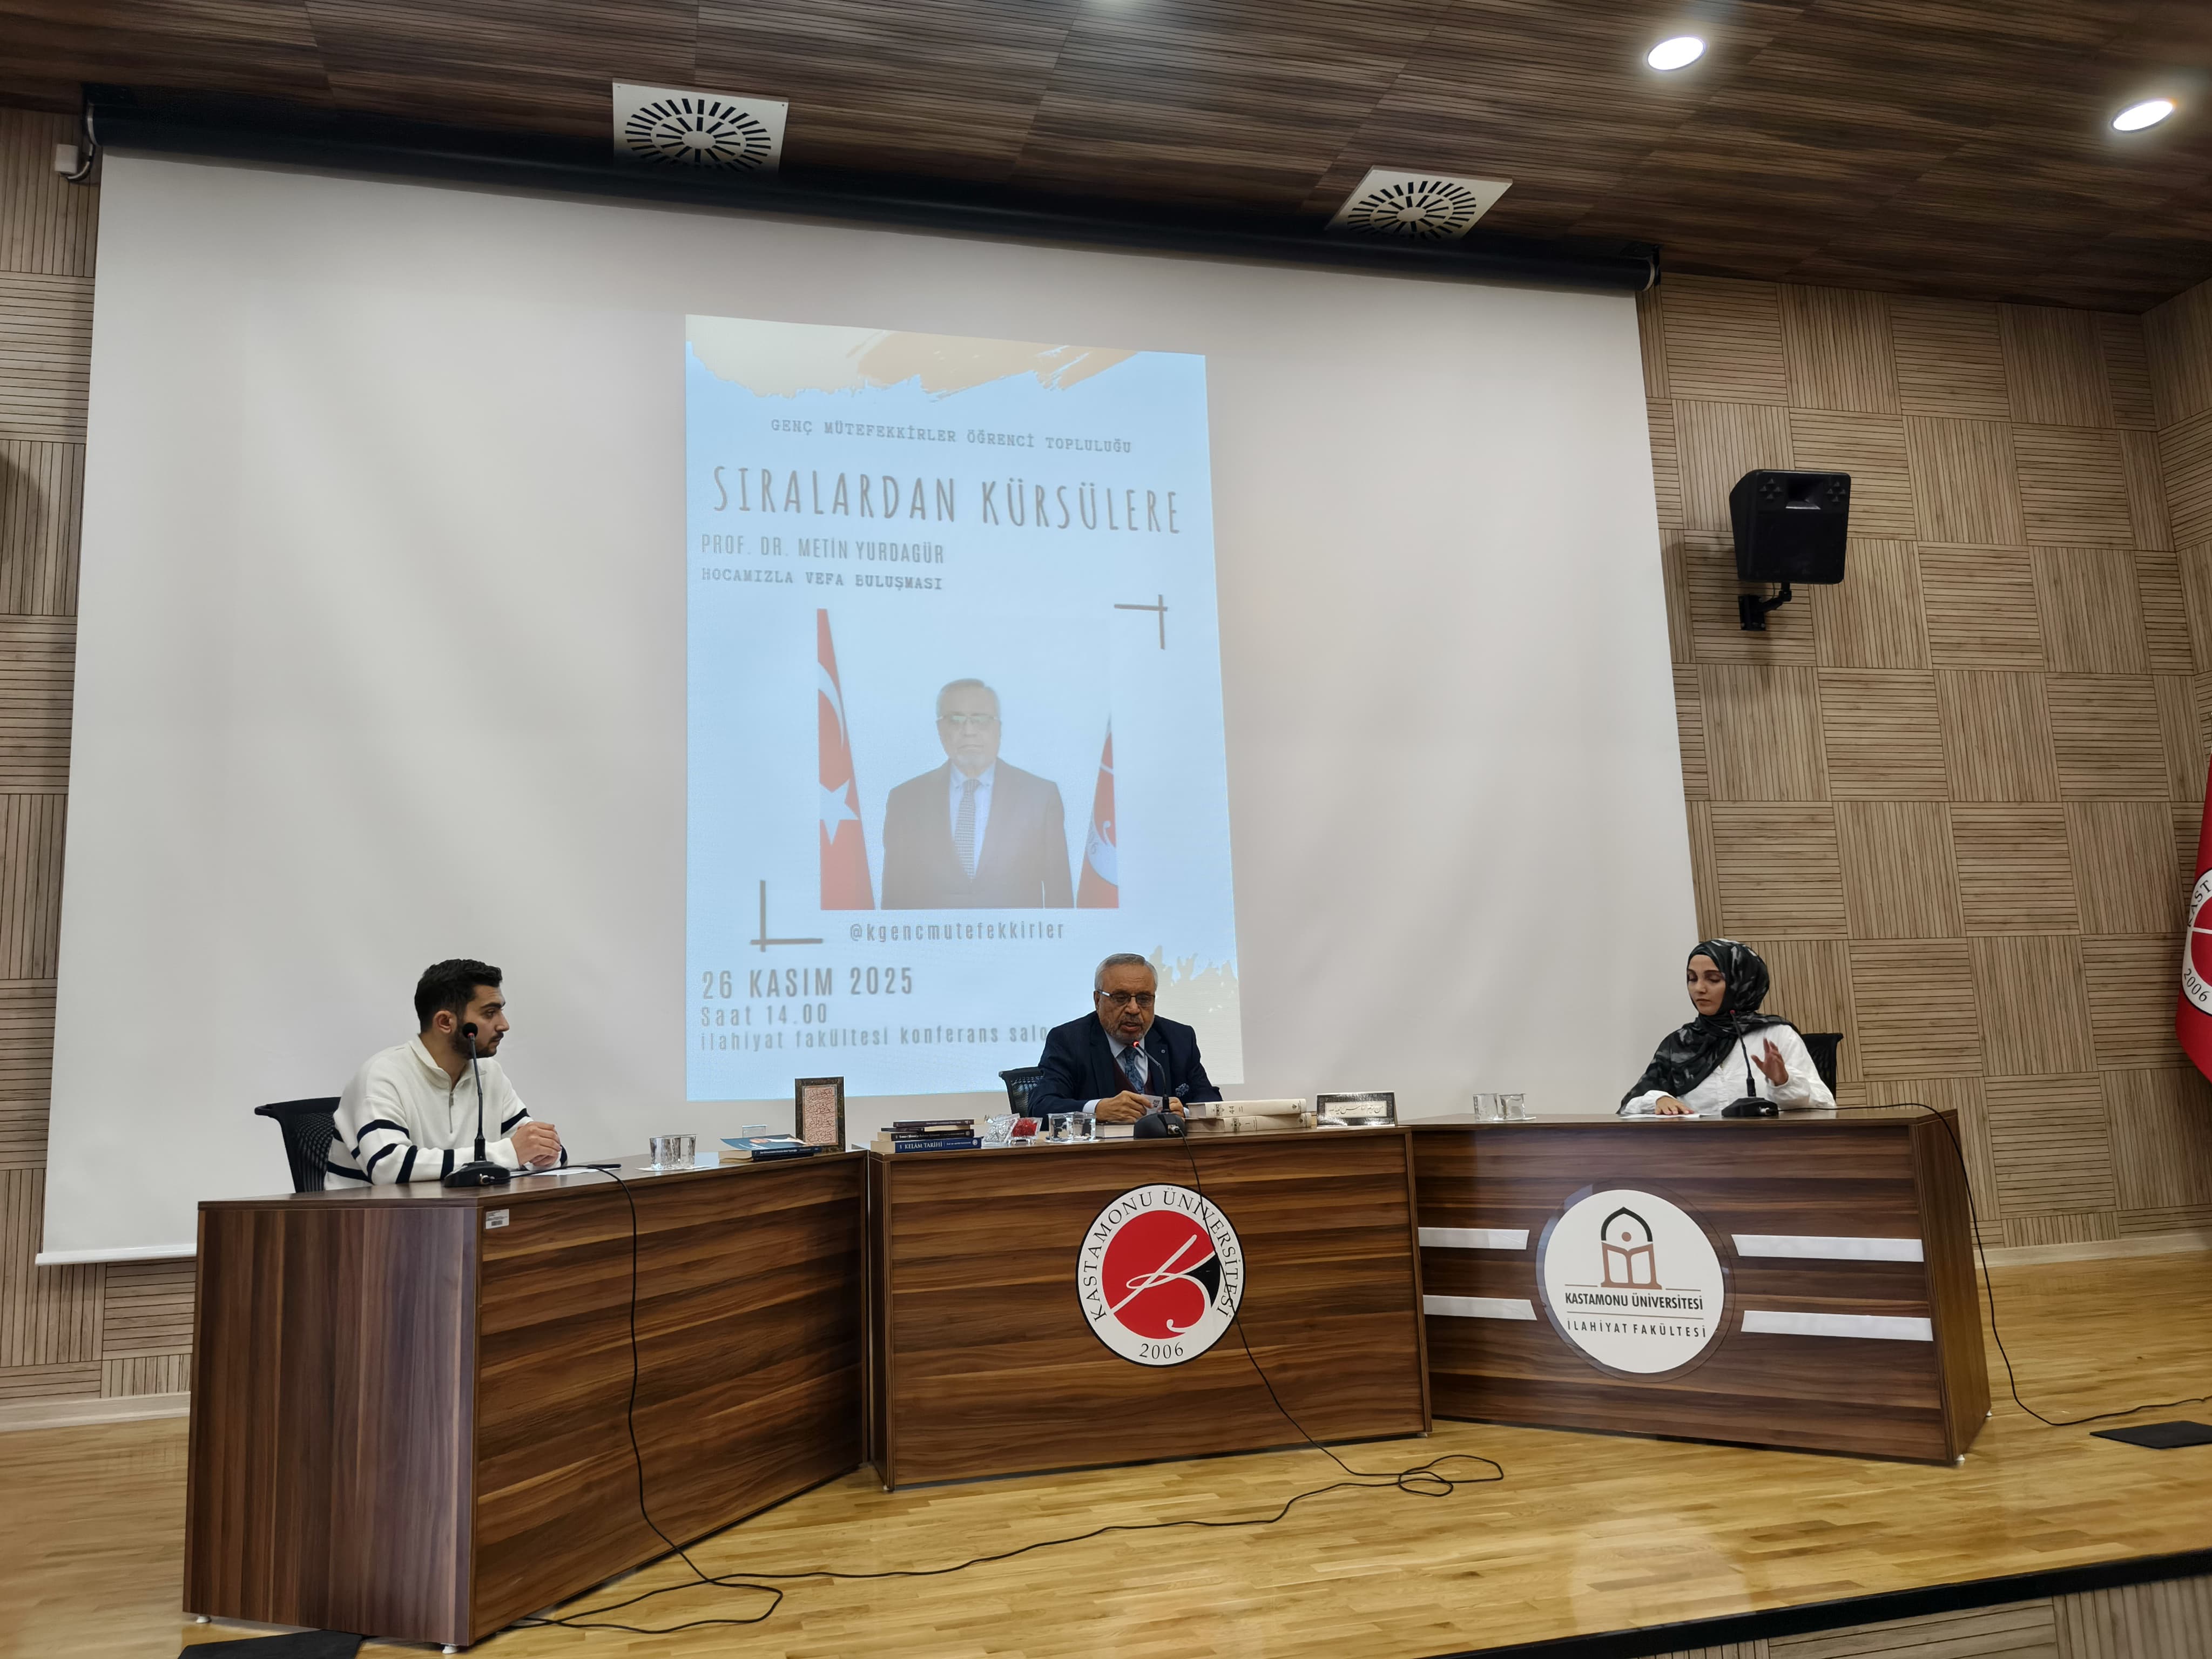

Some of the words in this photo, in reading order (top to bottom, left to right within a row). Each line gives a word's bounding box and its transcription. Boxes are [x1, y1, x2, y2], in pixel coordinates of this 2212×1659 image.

[771, 419, 813, 436] GENÇ
[824, 420, 956, 442] MÜTEFEKKİRLER
[967, 429, 1035, 448] ÖĞRENCİ
[1045, 437, 1132, 454] TOPLULUĞU
[713, 466, 955, 522] SIRALARDAN
[981, 477, 1180, 534] KÜRSÜLERE
[701, 534, 751, 555] PROF.
[760, 536, 788, 557] DR.
[798, 536, 848, 559] METİN
[855, 541, 944, 564] YURDAGÜR
[701, 568, 794, 584] HOCAMIZLA
[805, 571, 844, 587] VEFA
[855, 574, 943, 591] BULUŞMASI
[849, 920, 1064, 943] @kgencmutefekkirler
[702, 970, 732, 1000] 26
[749, 968, 833, 998] KASIM
[850, 966, 913, 995] 2025
[2183, 968, 2211, 1002] 2006
[701, 1006, 752, 1027] Saat
[766, 1003, 827, 1025] 14.00
[796, 1028, 888, 1048] fakültesi
[900, 1025, 999, 1044] konferans
[1009, 1024, 1047, 1042] salo
[1083, 1191, 1153, 1322] KASTAMONU
[1565, 1292, 1628, 1306] KASTAMONU
[1631, 1292, 1703, 1310] ÜNİVERSİTESİ
[1567, 1318, 1628, 1333] İLAHİYAT
[1633, 1323, 1706, 1338] FAKÜLTESİ
[1139, 1341, 1184, 1359] 2006
